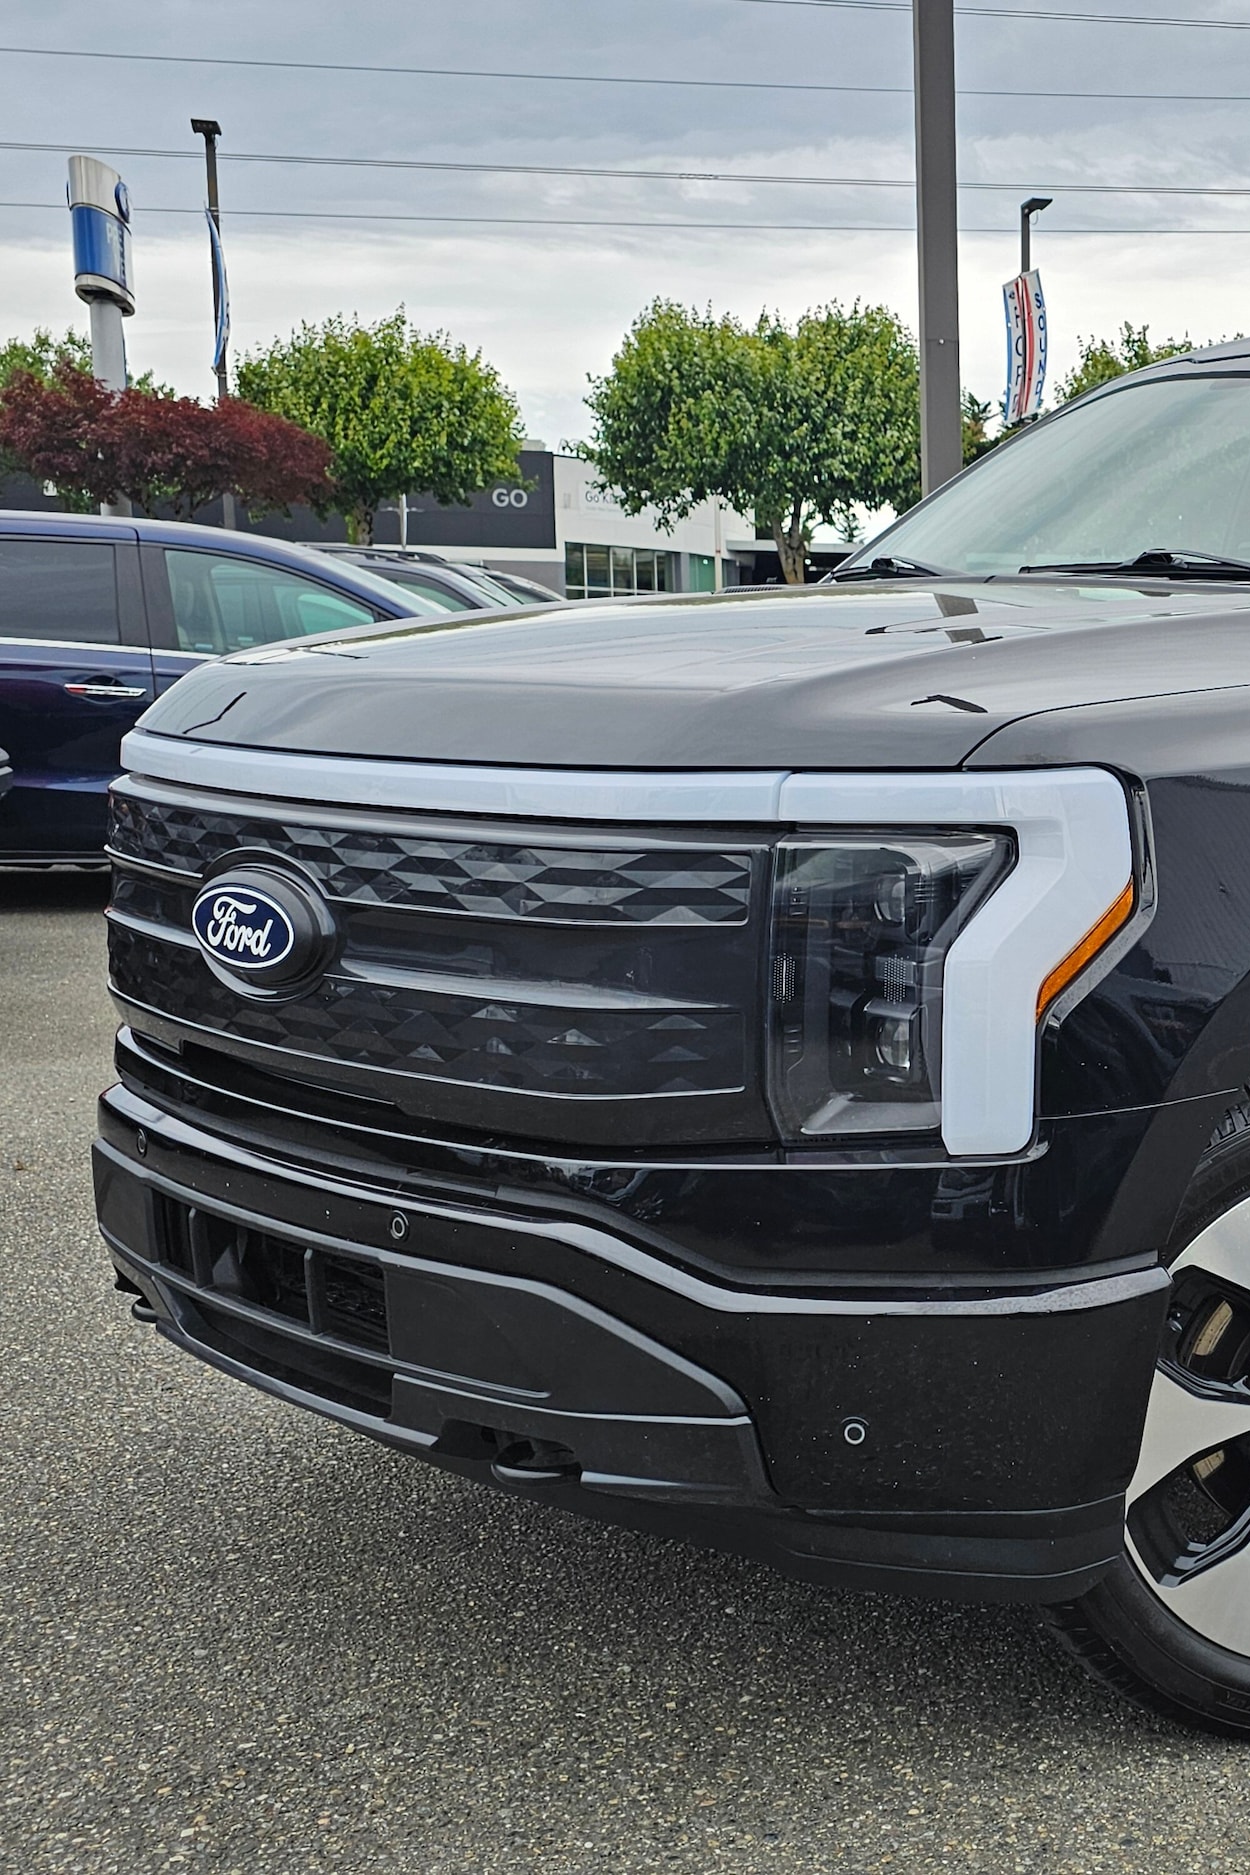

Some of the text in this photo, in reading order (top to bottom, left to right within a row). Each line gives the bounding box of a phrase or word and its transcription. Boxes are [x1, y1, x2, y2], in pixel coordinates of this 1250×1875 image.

[1033, 292, 1046, 398] SOUND
[491, 487, 529, 509] GO
[585, 490, 600, 503] Go
[206, 894, 275, 958] Ford
